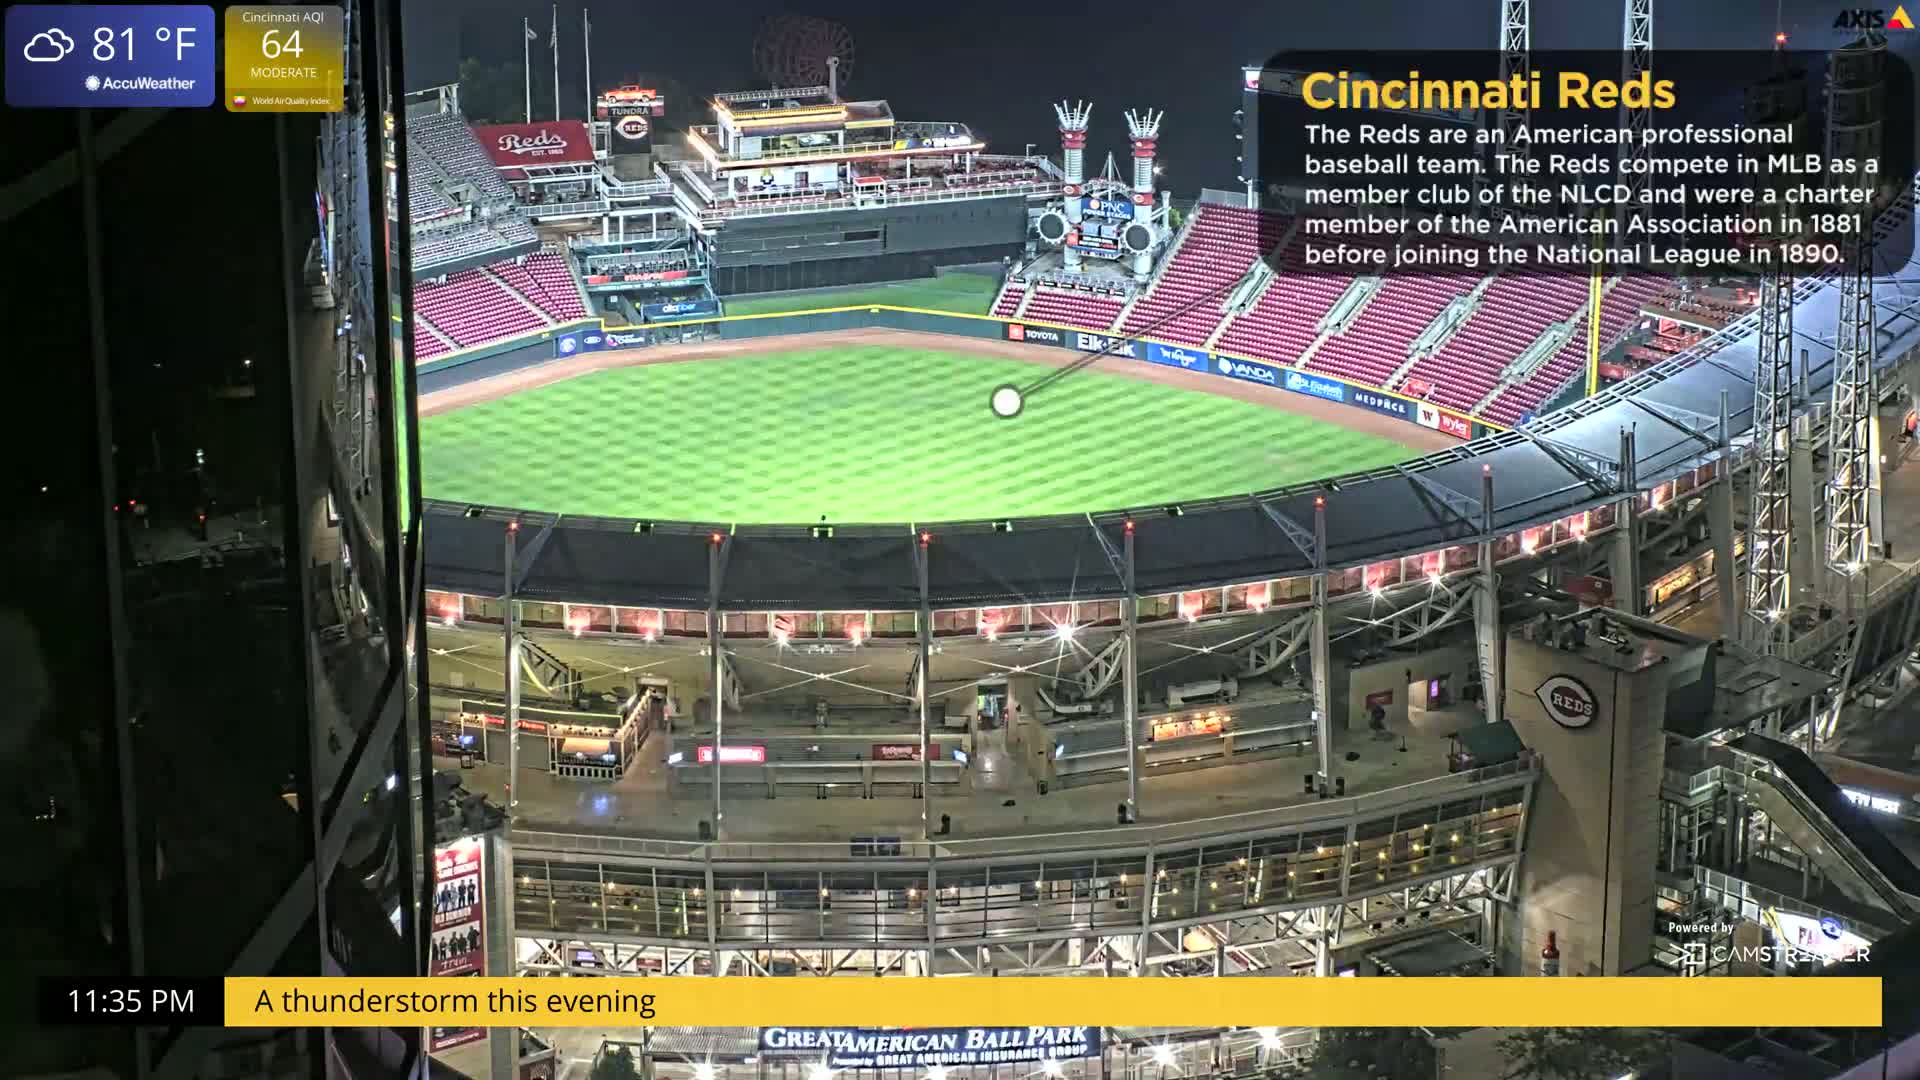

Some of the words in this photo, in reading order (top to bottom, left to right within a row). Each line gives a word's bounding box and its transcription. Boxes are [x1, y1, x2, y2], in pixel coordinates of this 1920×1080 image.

[611, 107, 649, 115] TUNDRA
[624, 124, 648, 132] REDS
[498, 130, 567, 152] Reds
[1101, 200, 1125, 213] PNC
[1026, 329, 1058, 341] TOYOTA
[1232, 362, 1274, 380] VANDA
[1422, 410, 1433, 422] W
[1552, 693, 1593, 715] REDS
